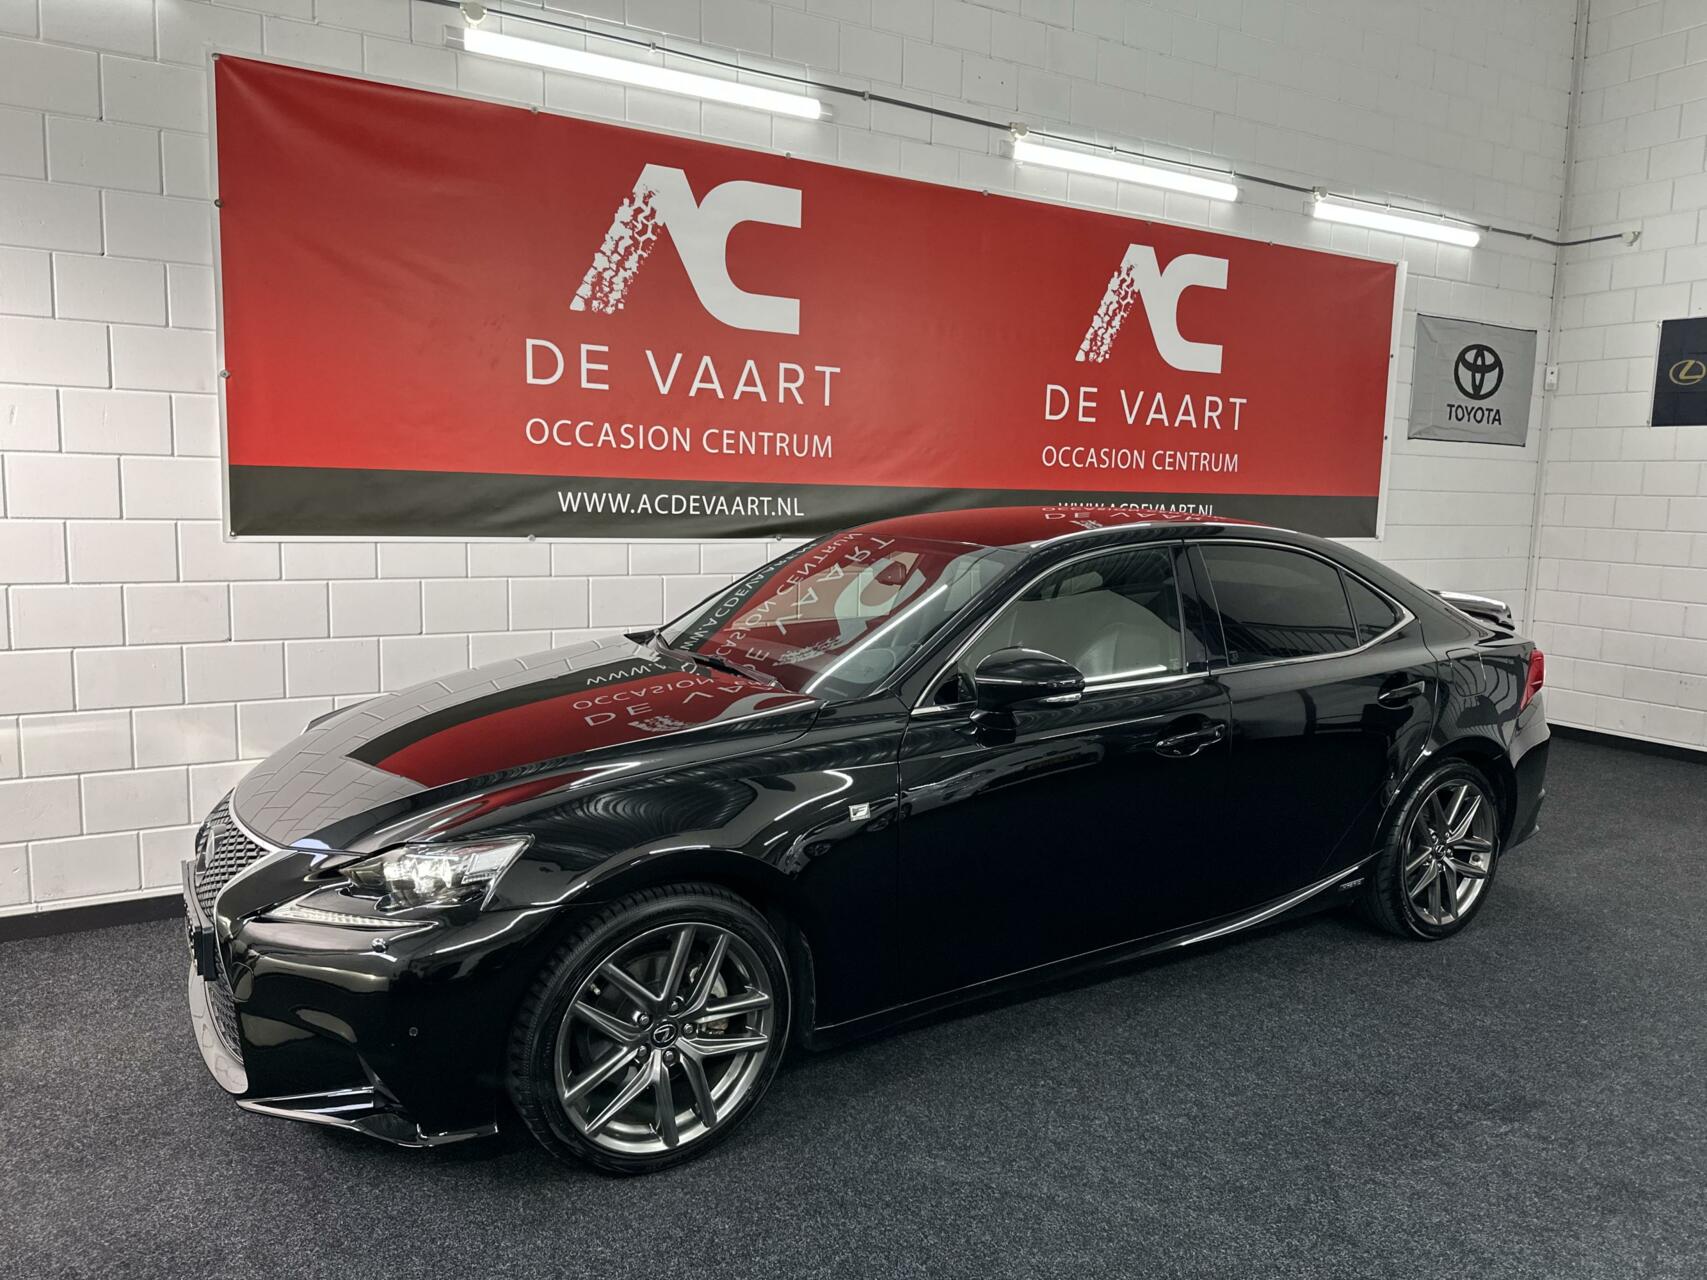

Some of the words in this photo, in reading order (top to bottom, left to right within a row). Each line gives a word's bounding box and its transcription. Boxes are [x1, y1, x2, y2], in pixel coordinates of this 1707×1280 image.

[525, 338, 610, 390] DE
[645, 349, 841, 406] VAART
[1044, 383, 1098, 423] DE
[1120, 389, 1248, 431] VAART
[1447, 403, 1502, 426] TOYOTA
[525, 417, 691, 452] OCCASION
[702, 429, 833, 458] CENTRUM
[1042, 445, 1146, 470] OCCASION
[1152, 450, 1239, 472] CENTRUM
[557, 491, 804, 516] WWW.ACDEVAART.NL
